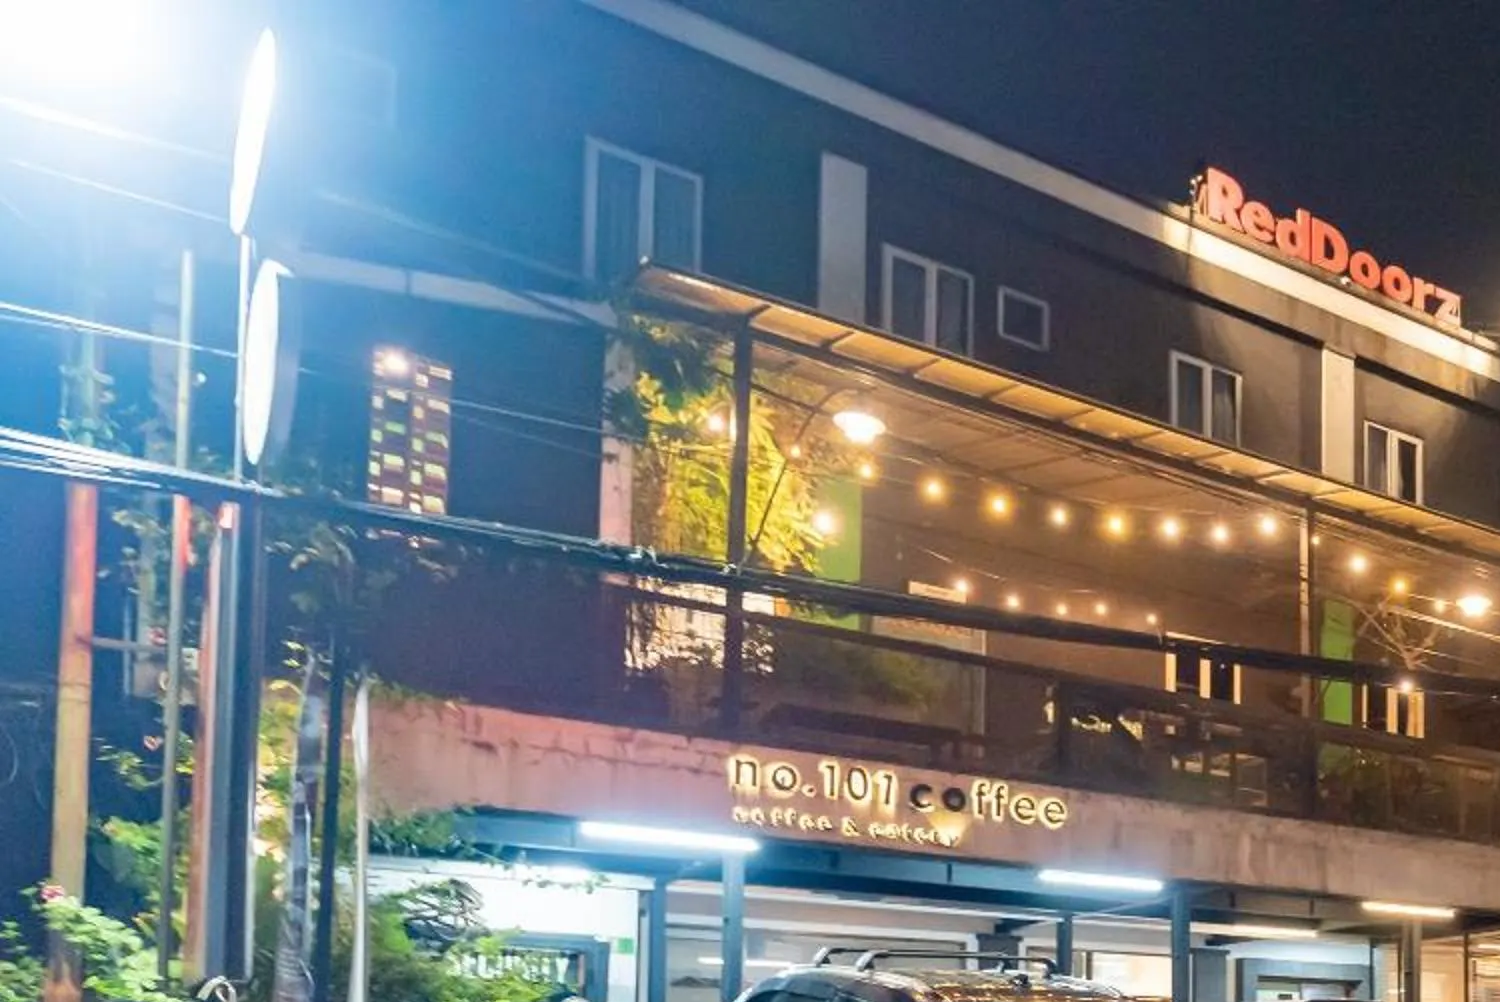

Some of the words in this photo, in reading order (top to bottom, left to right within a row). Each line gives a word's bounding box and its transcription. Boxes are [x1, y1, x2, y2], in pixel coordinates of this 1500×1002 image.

[1206, 166, 1462, 328] RedDoorz
[729, 755, 897, 806] no.101
[907, 778, 1068, 829] coffee
[732, 806, 833, 832] coffee
[840, 815, 861, 838] &
